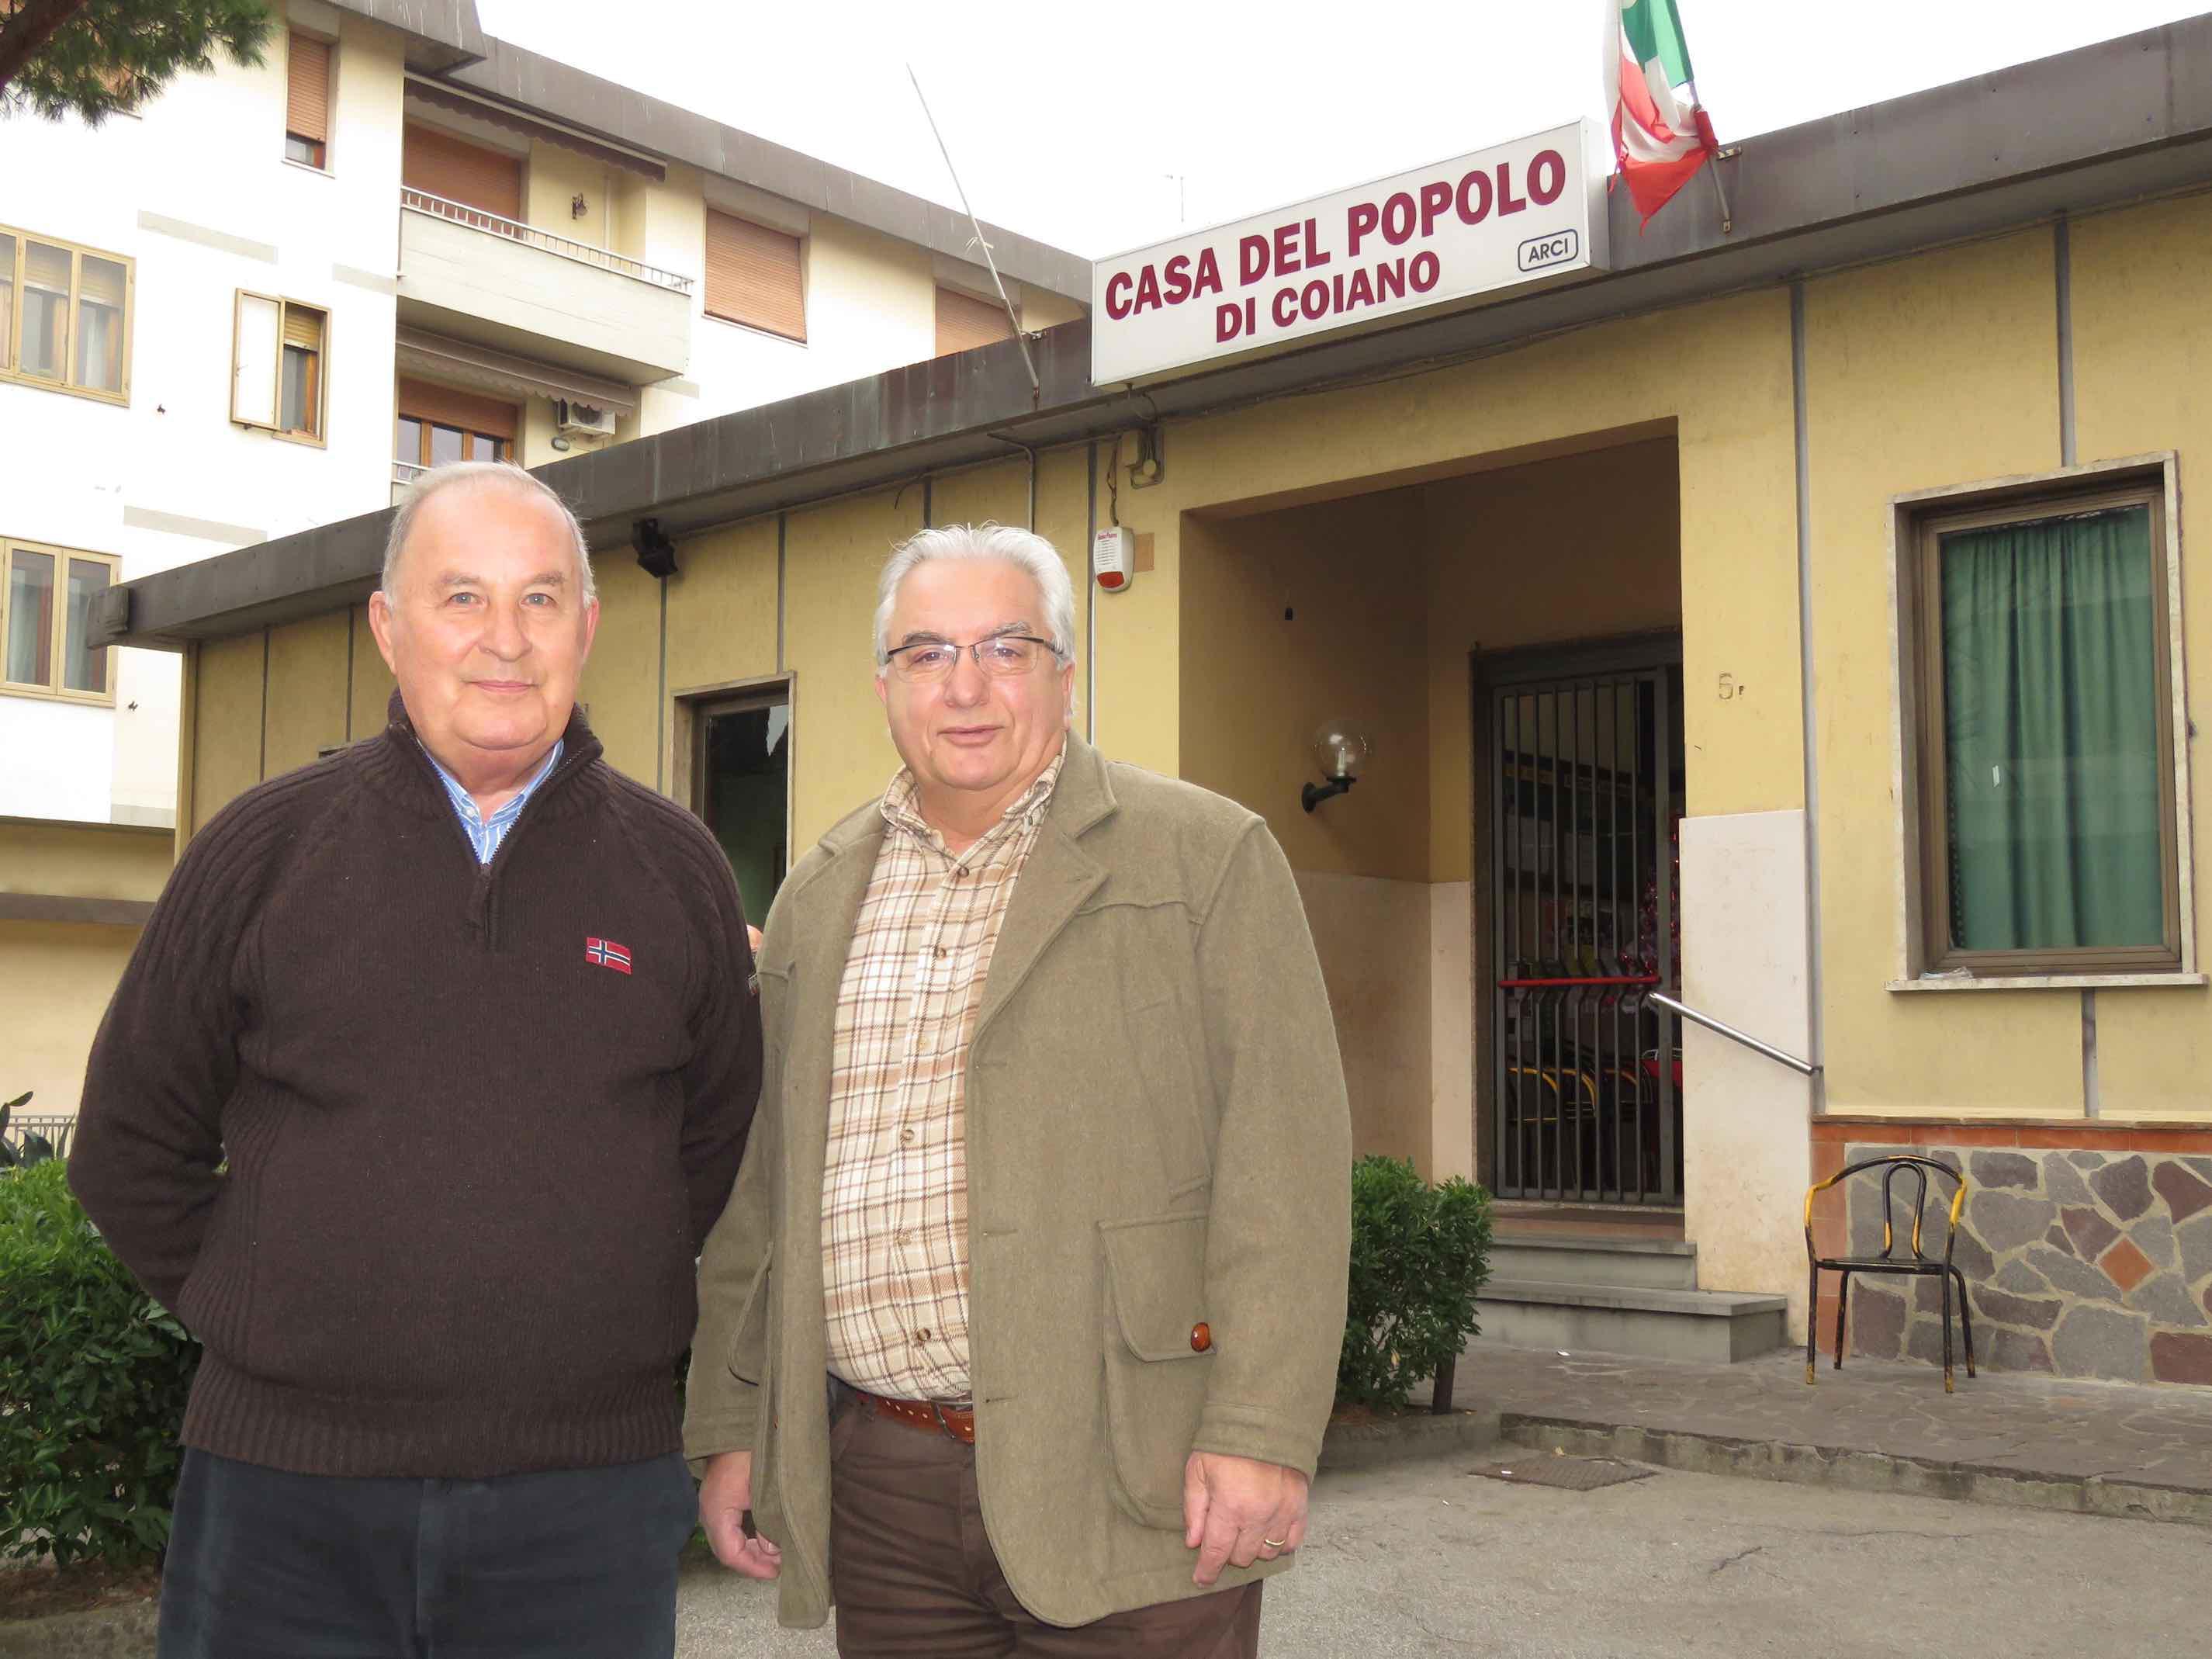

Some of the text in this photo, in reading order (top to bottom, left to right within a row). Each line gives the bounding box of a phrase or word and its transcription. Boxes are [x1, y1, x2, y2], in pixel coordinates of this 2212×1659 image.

[1106, 149, 1566, 320] CASA DEL POPOLO
[1528, 237, 1568, 263] ARCI
[1216, 251, 1440, 342] DI COIANO
